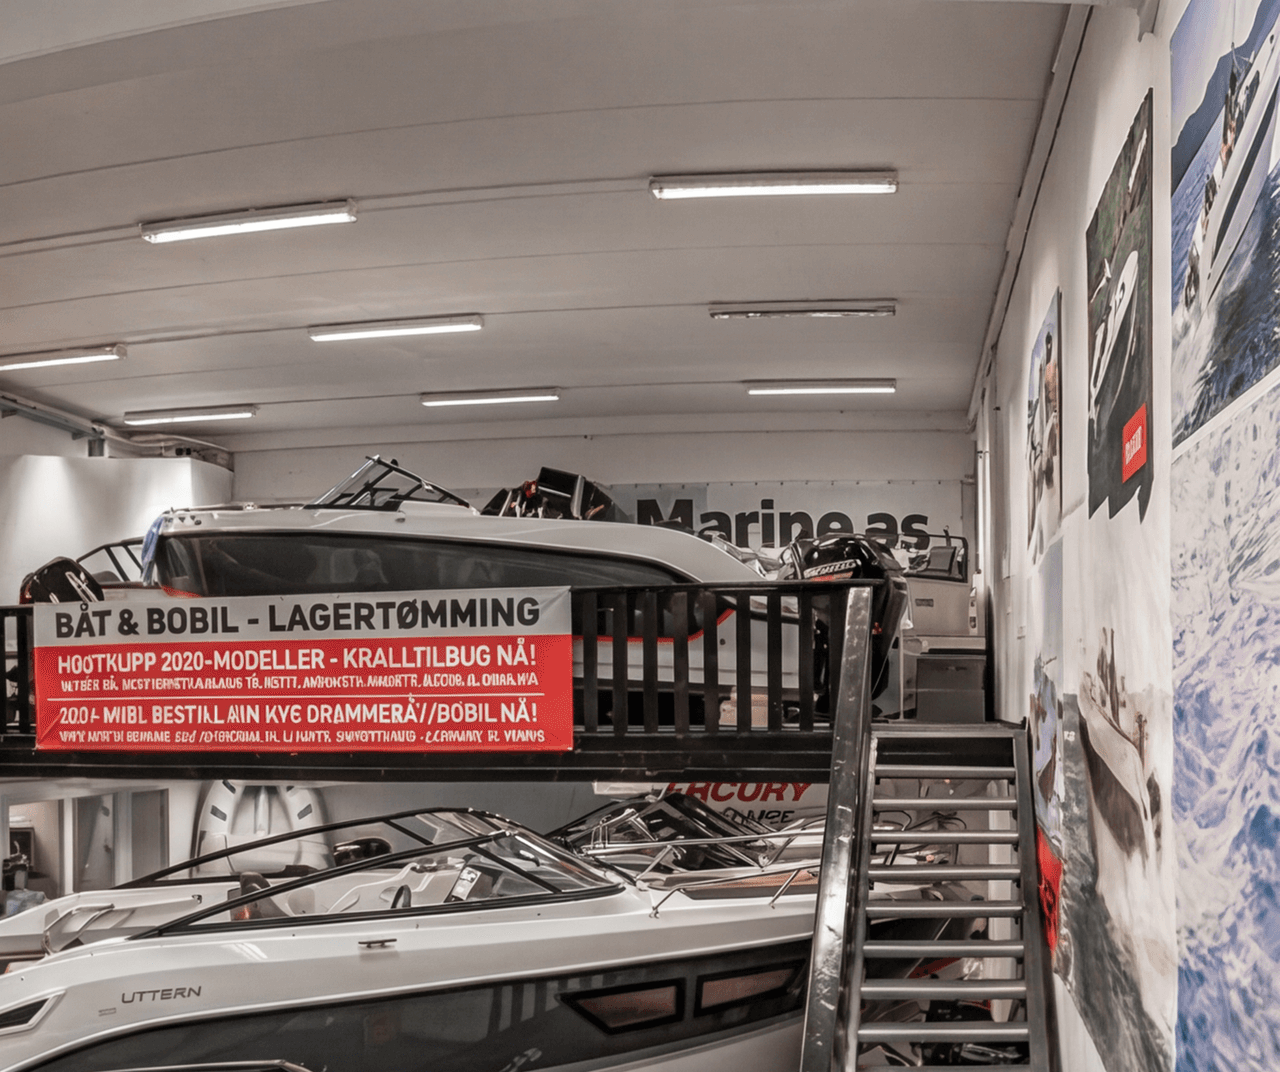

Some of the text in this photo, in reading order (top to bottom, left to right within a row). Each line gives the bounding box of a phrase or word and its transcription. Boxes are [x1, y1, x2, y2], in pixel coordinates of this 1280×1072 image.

[865, 512, 931, 550] as
[55, 602, 112, 638] BÅT
[118, 608, 139, 636] &
[147, 606, 239, 635] BOBIL
[269, 597, 540, 632] LAGERTØMMING
[161, 647, 325, 672] 2020-MODELLER
[497, 637, 536, 667] NÅ!
[121, 986, 202, 1004] UTTERN
